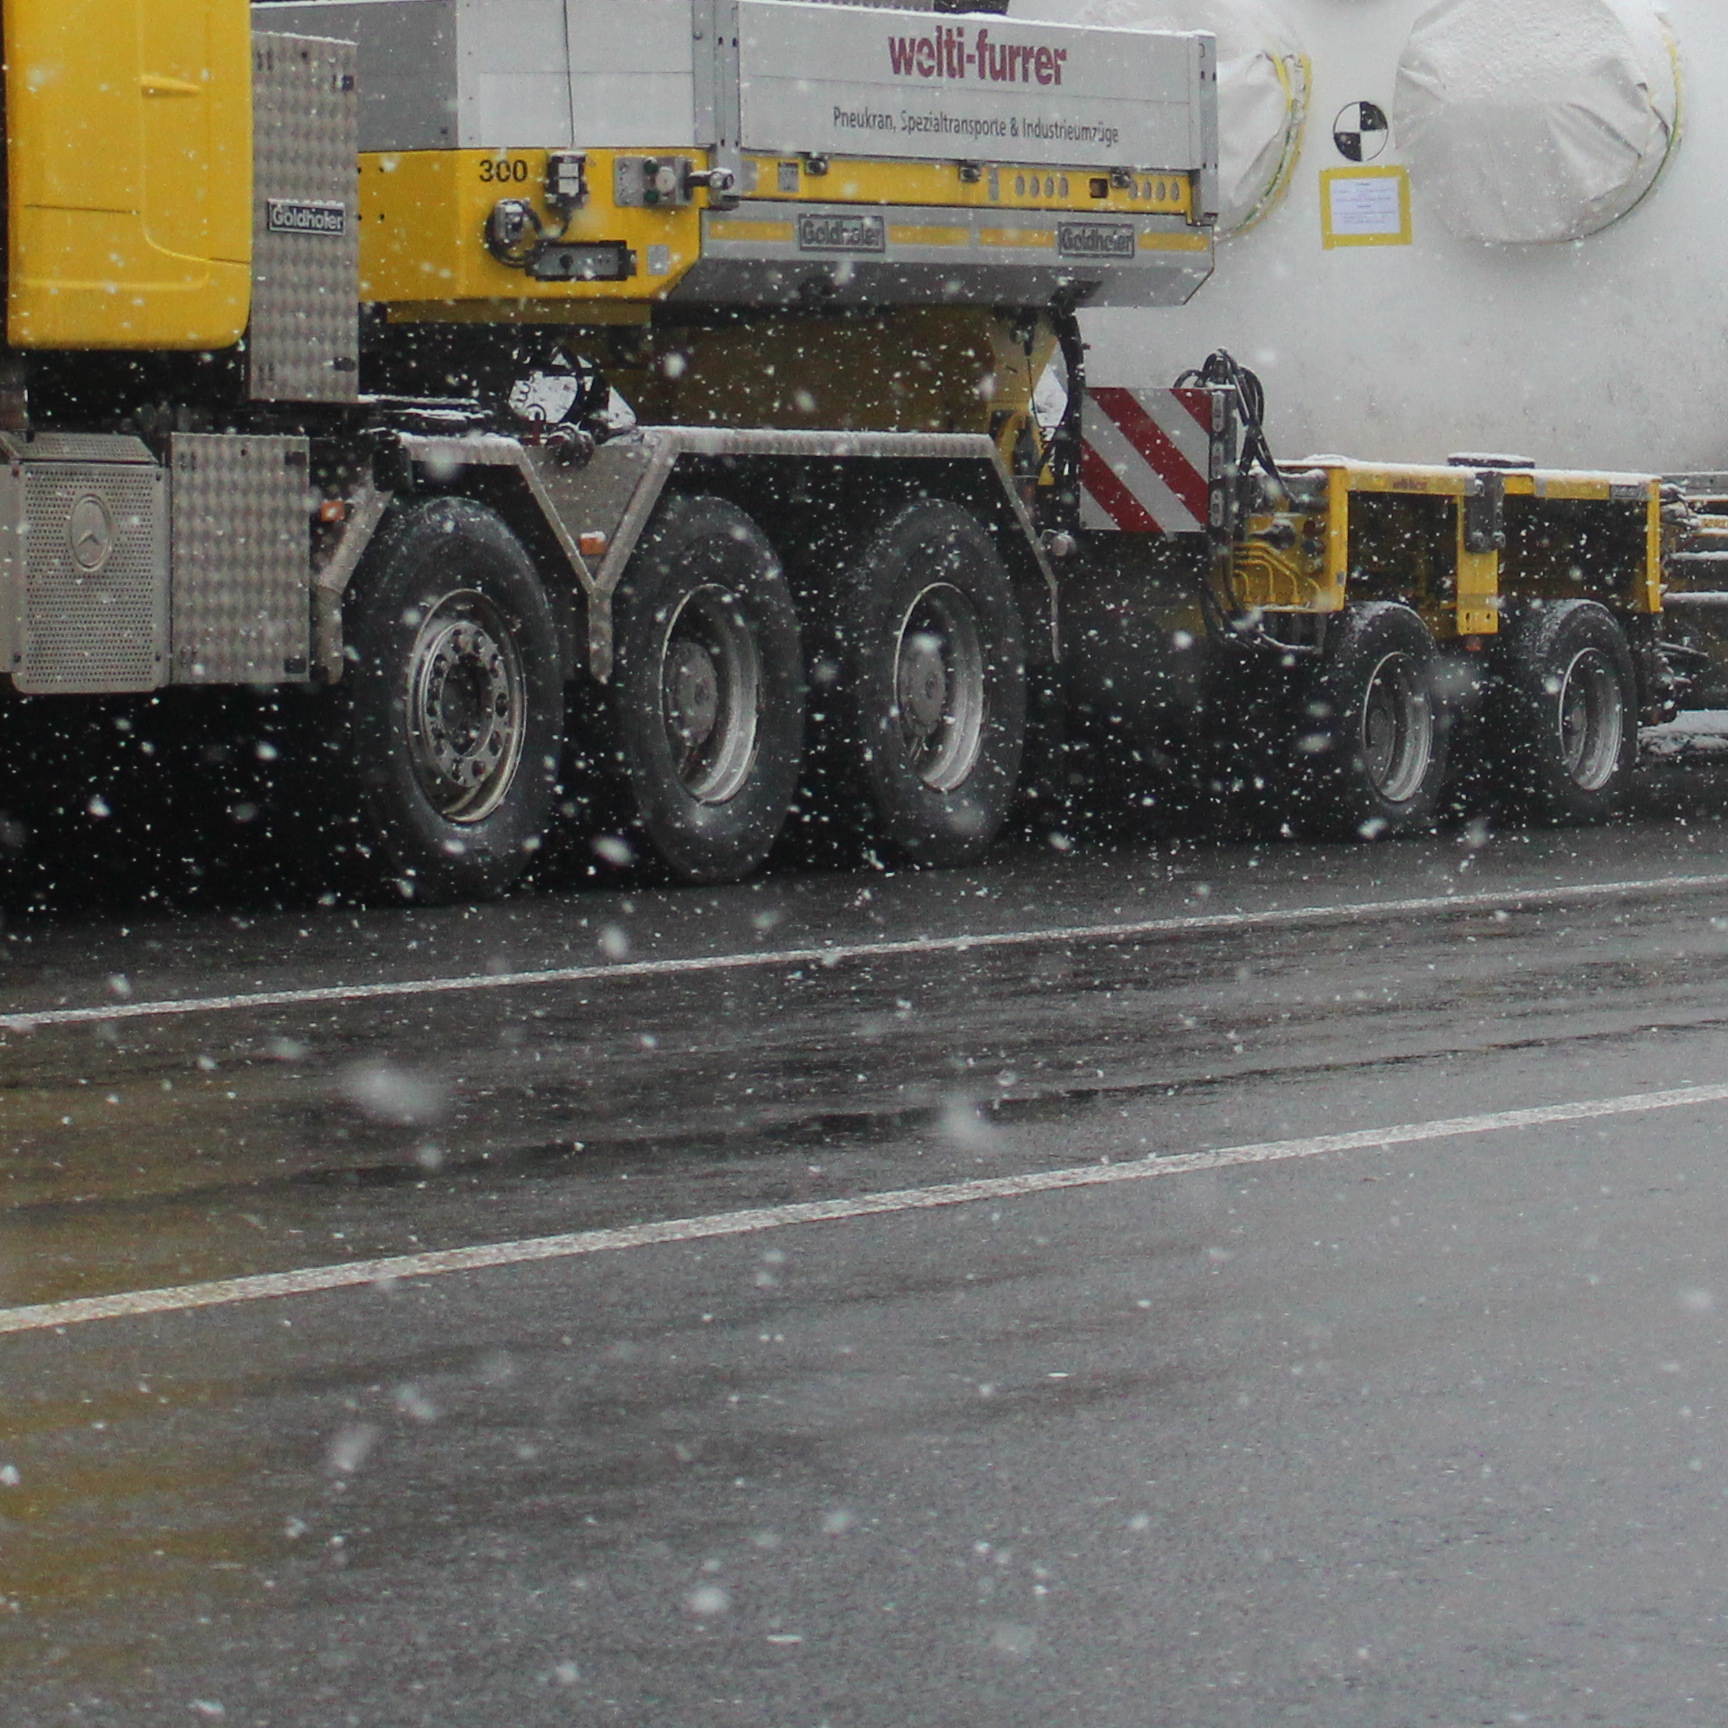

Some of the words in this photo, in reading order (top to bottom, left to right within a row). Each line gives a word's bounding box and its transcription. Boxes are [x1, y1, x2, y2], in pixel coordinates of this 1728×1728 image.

[889, 25, 1067, 85] welti-furrer
[833, 106, 897, 132] Pneukran,
[900, 110, 1006, 140] Spezialtransporte
[1010, 117, 1020, 137] &
[479, 159, 527, 182] 300
